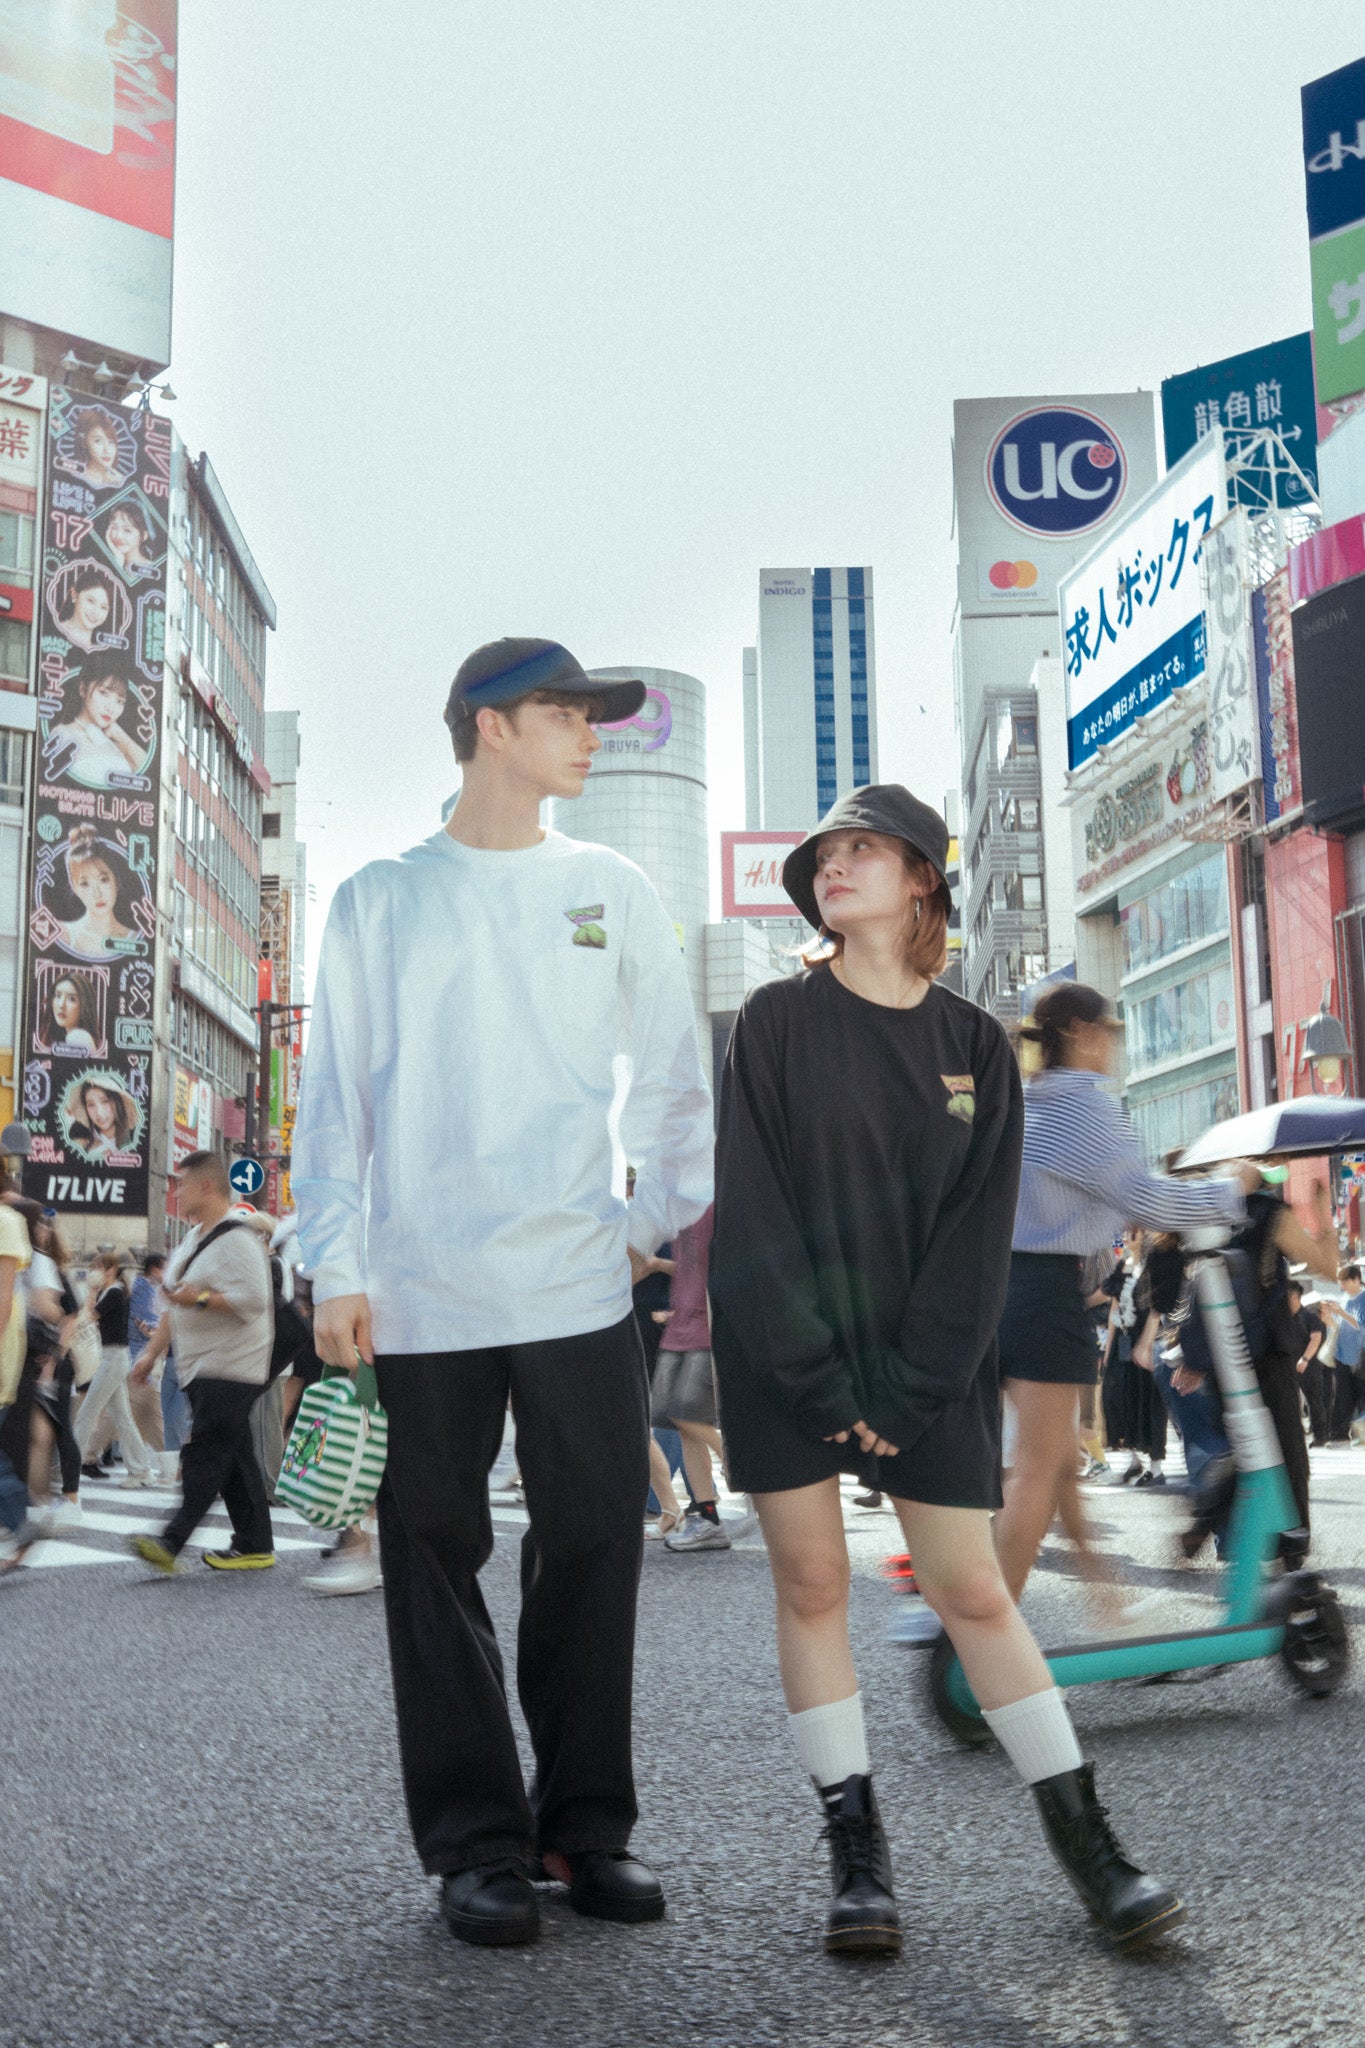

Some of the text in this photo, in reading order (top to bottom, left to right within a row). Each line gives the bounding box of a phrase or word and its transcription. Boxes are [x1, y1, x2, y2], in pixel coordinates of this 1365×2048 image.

[1194, 378, 1283, 443] 龍角散
[50, 510, 94, 552] 17
[764, 587, 806, 596] INDIGO
[991, 590, 1037, 599] mastercard
[1066, 494, 1214, 677] 求人ボックス
[1082, 654, 1186, 746] あなたの明日が、詰まってる。
[601, 739, 640, 753] IBUYA
[97, 793, 155, 828] LIVE
[744, 860, 783, 888] H&M
[47, 1174, 127, 1204] 17LIVE
